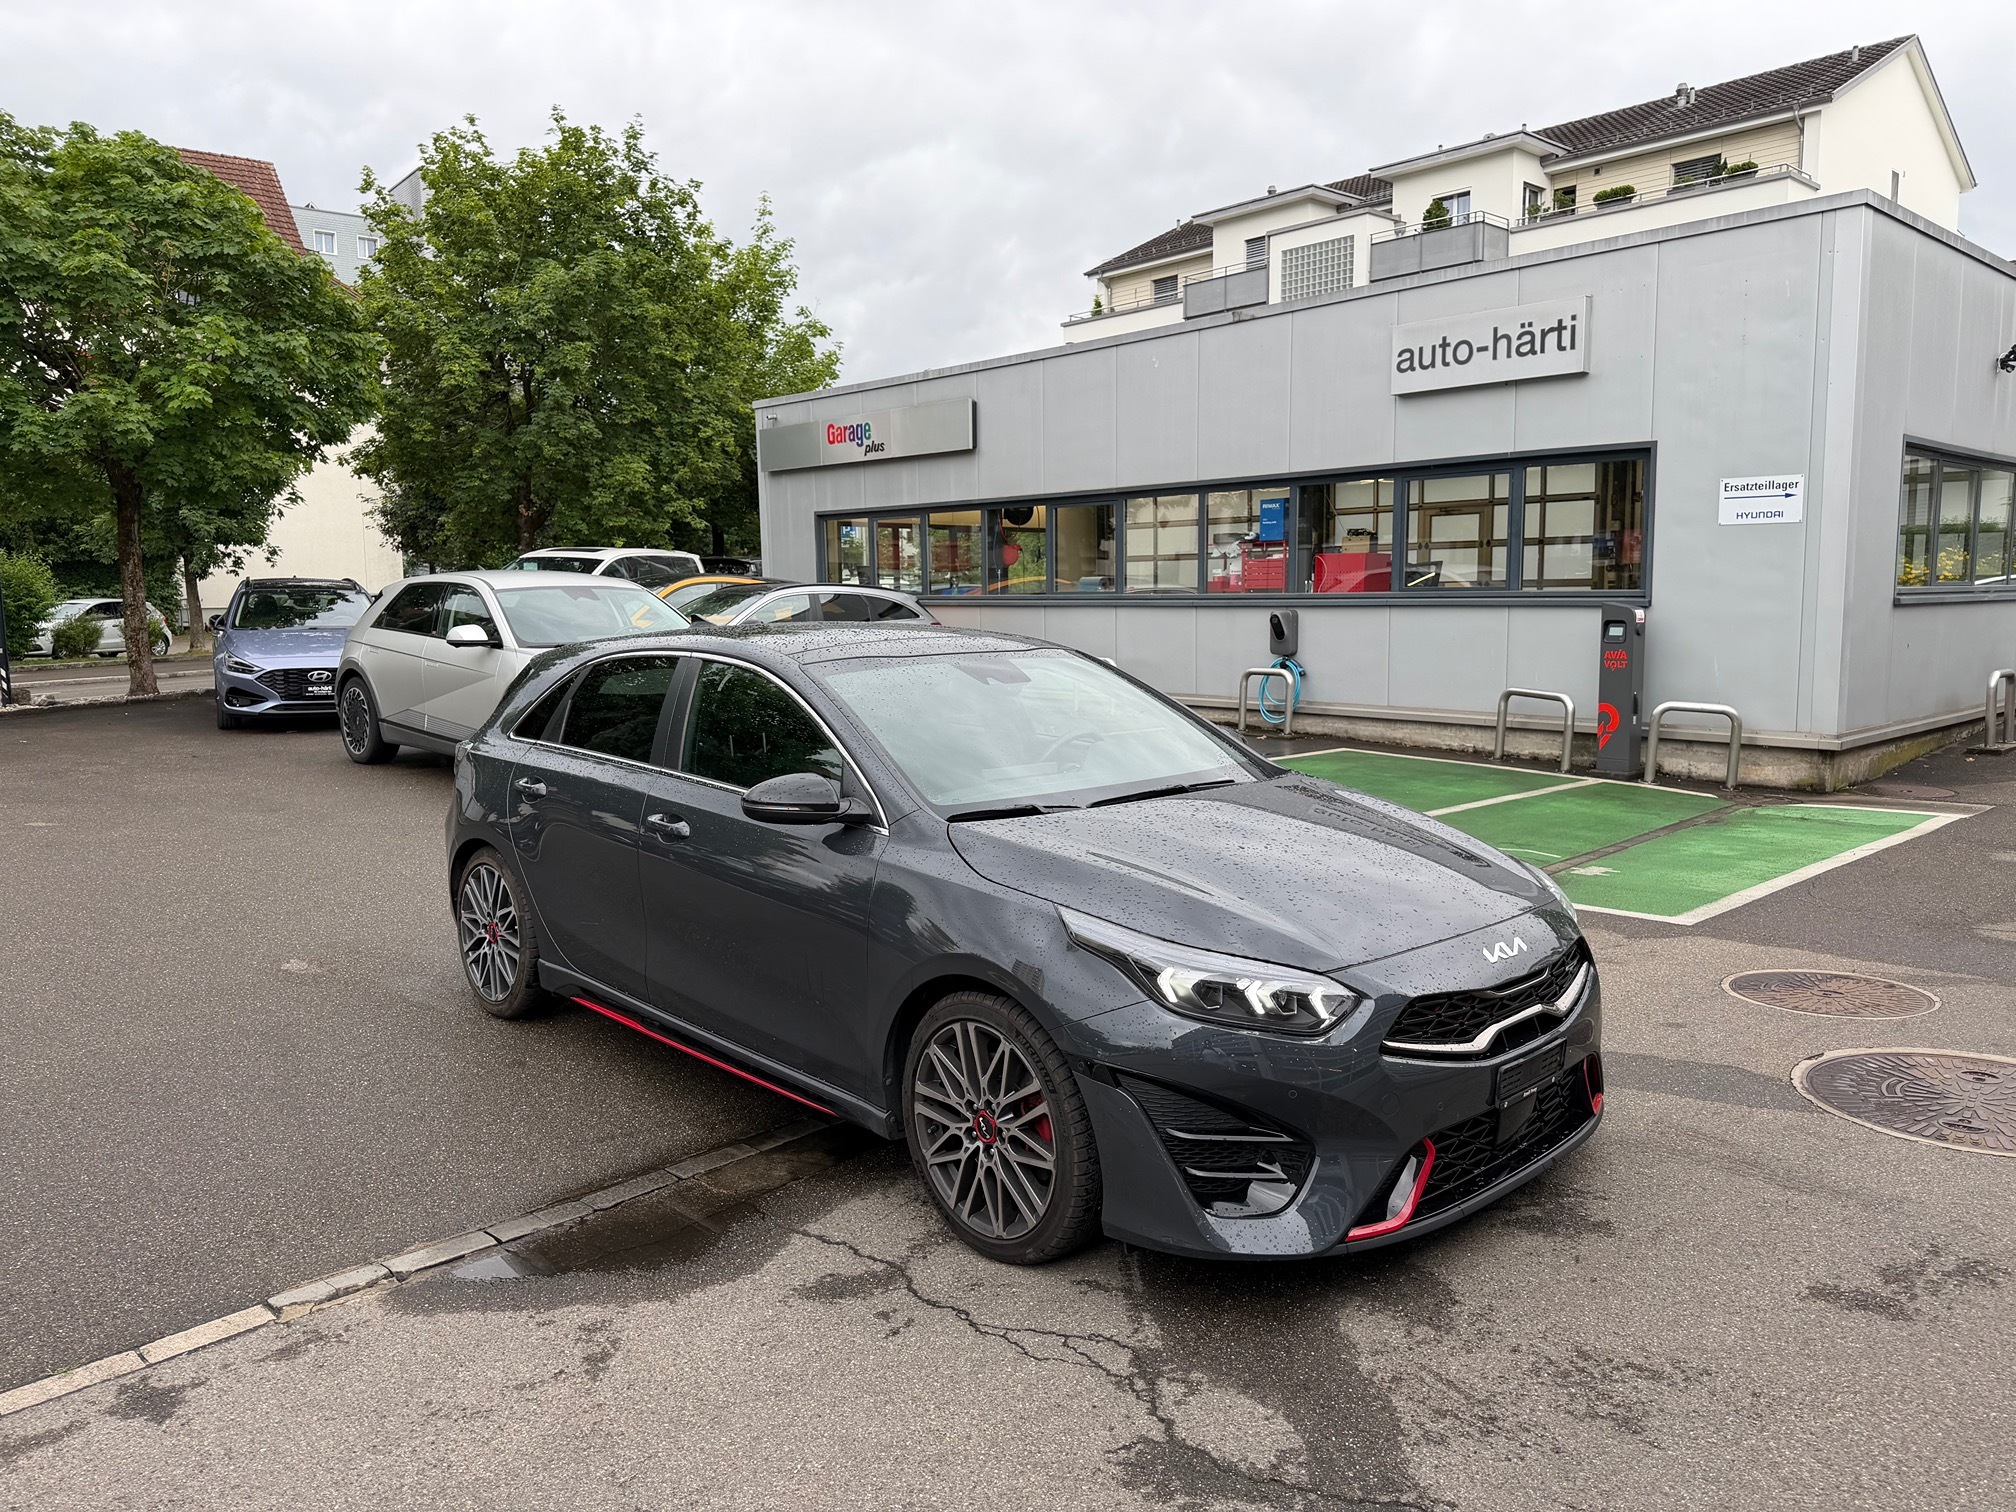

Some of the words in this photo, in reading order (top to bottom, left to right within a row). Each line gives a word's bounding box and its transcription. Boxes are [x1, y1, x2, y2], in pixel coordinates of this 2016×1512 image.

[1396, 314, 1577, 373] auto-härti
[827, 422, 871, 447] Garage
[864, 441, 885, 456] plus
[1724, 480, 1799, 492] Ersatzteillager
[1736, 510, 1784, 519] HYUNDAI
[1604, 649, 1627, 659] AVIA
[1604, 661, 1627, 671] VOLT
[1017, 1034, 1055, 1091] MICHELIN
